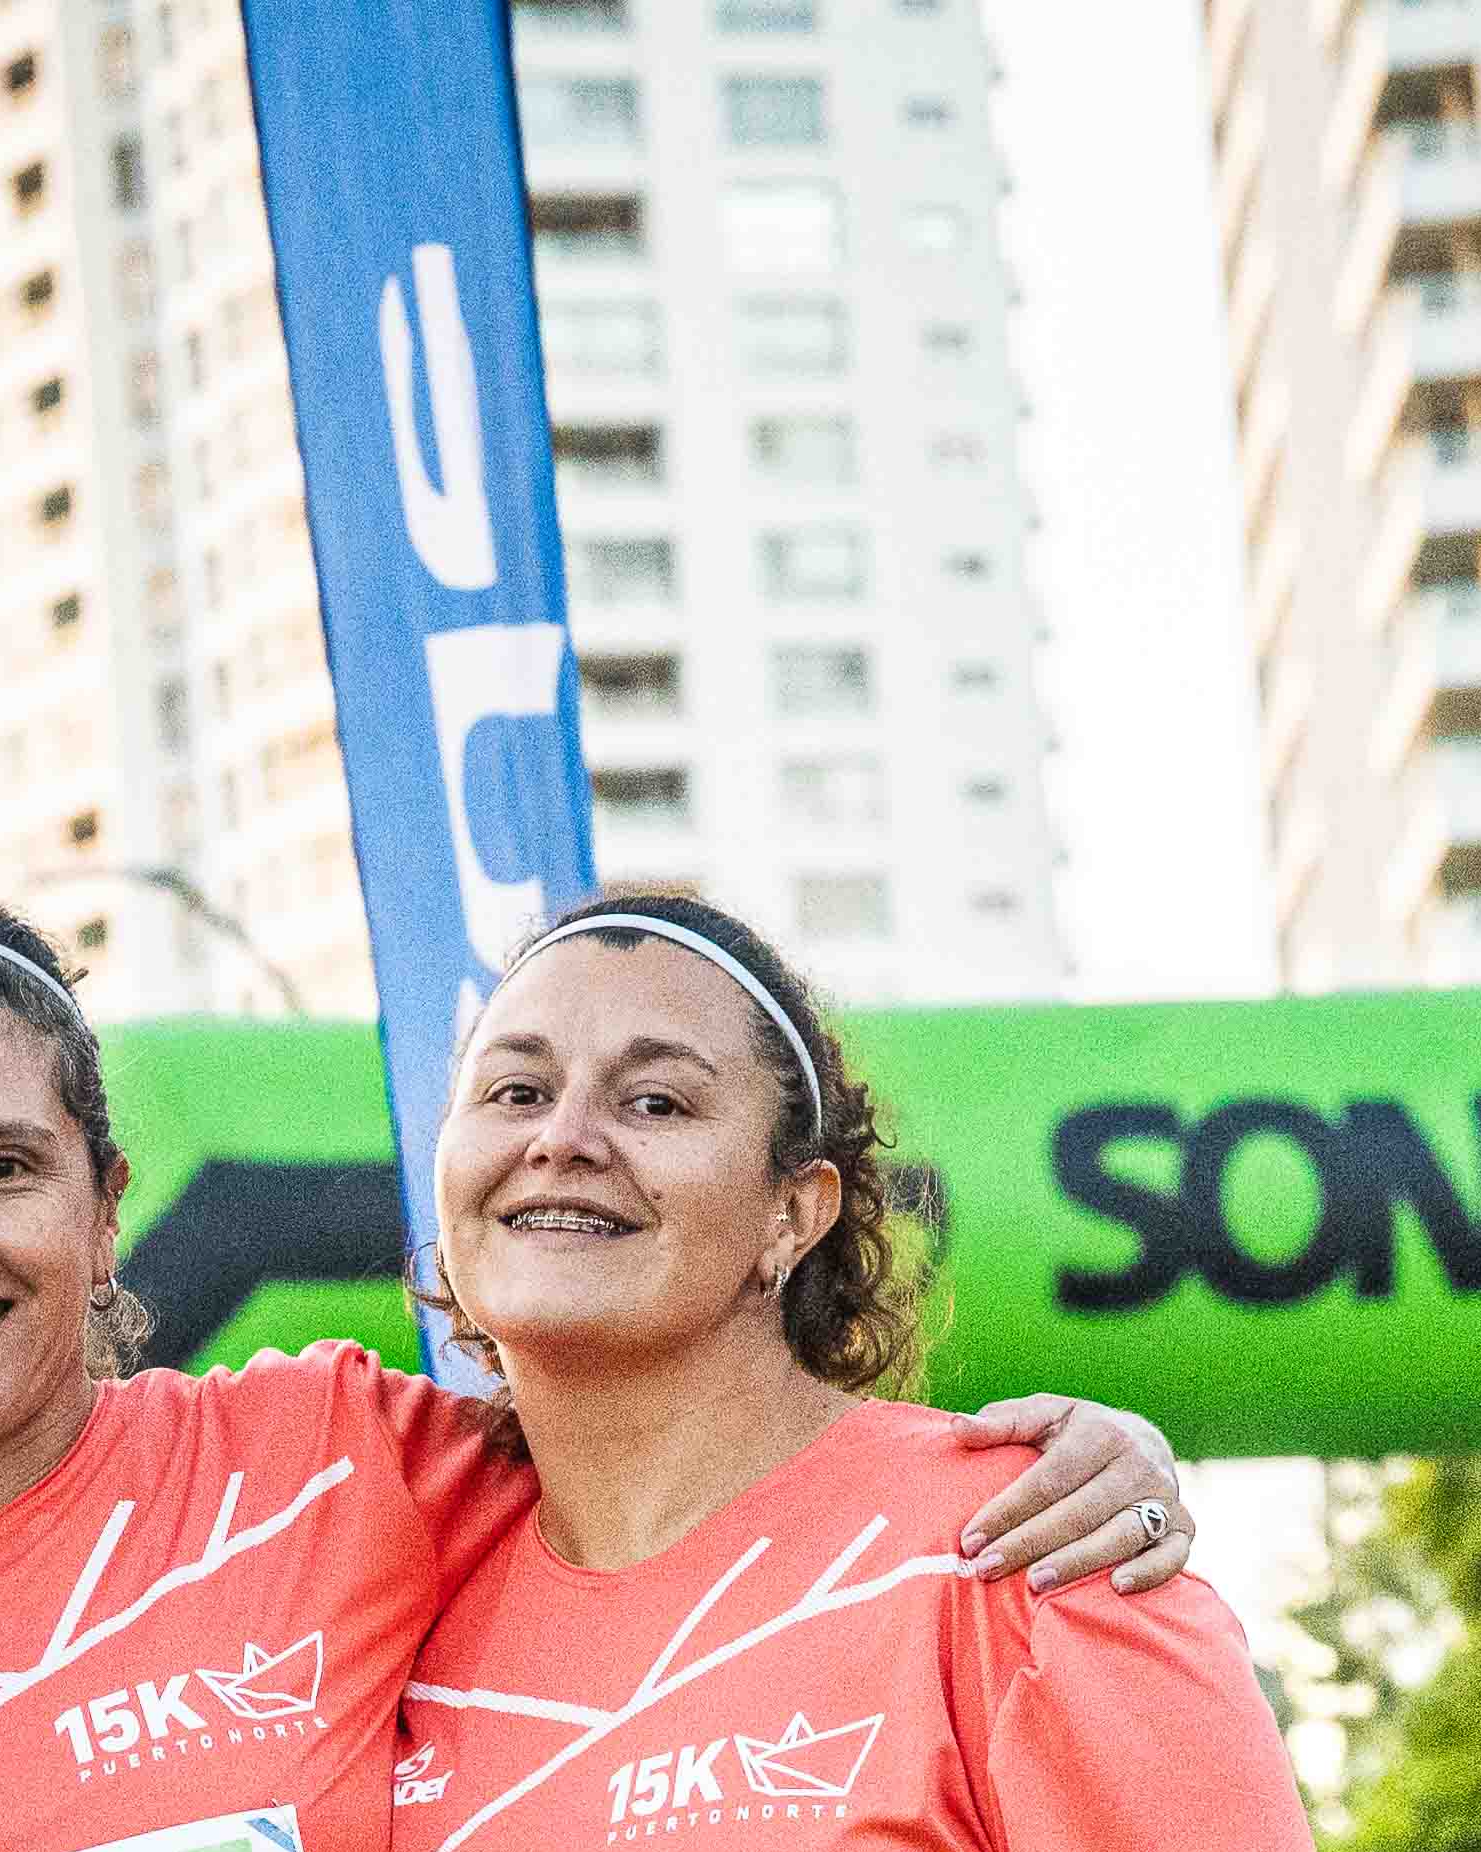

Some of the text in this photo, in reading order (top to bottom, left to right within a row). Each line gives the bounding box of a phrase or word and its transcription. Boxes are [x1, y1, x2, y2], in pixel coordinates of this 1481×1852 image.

[53, 1673, 209, 1765] 15K
[79, 1716, 330, 1783] PUERTO NORTE
[608, 1737, 729, 1823] 15K
[606, 1804, 848, 1845] PUERTO NORTE
